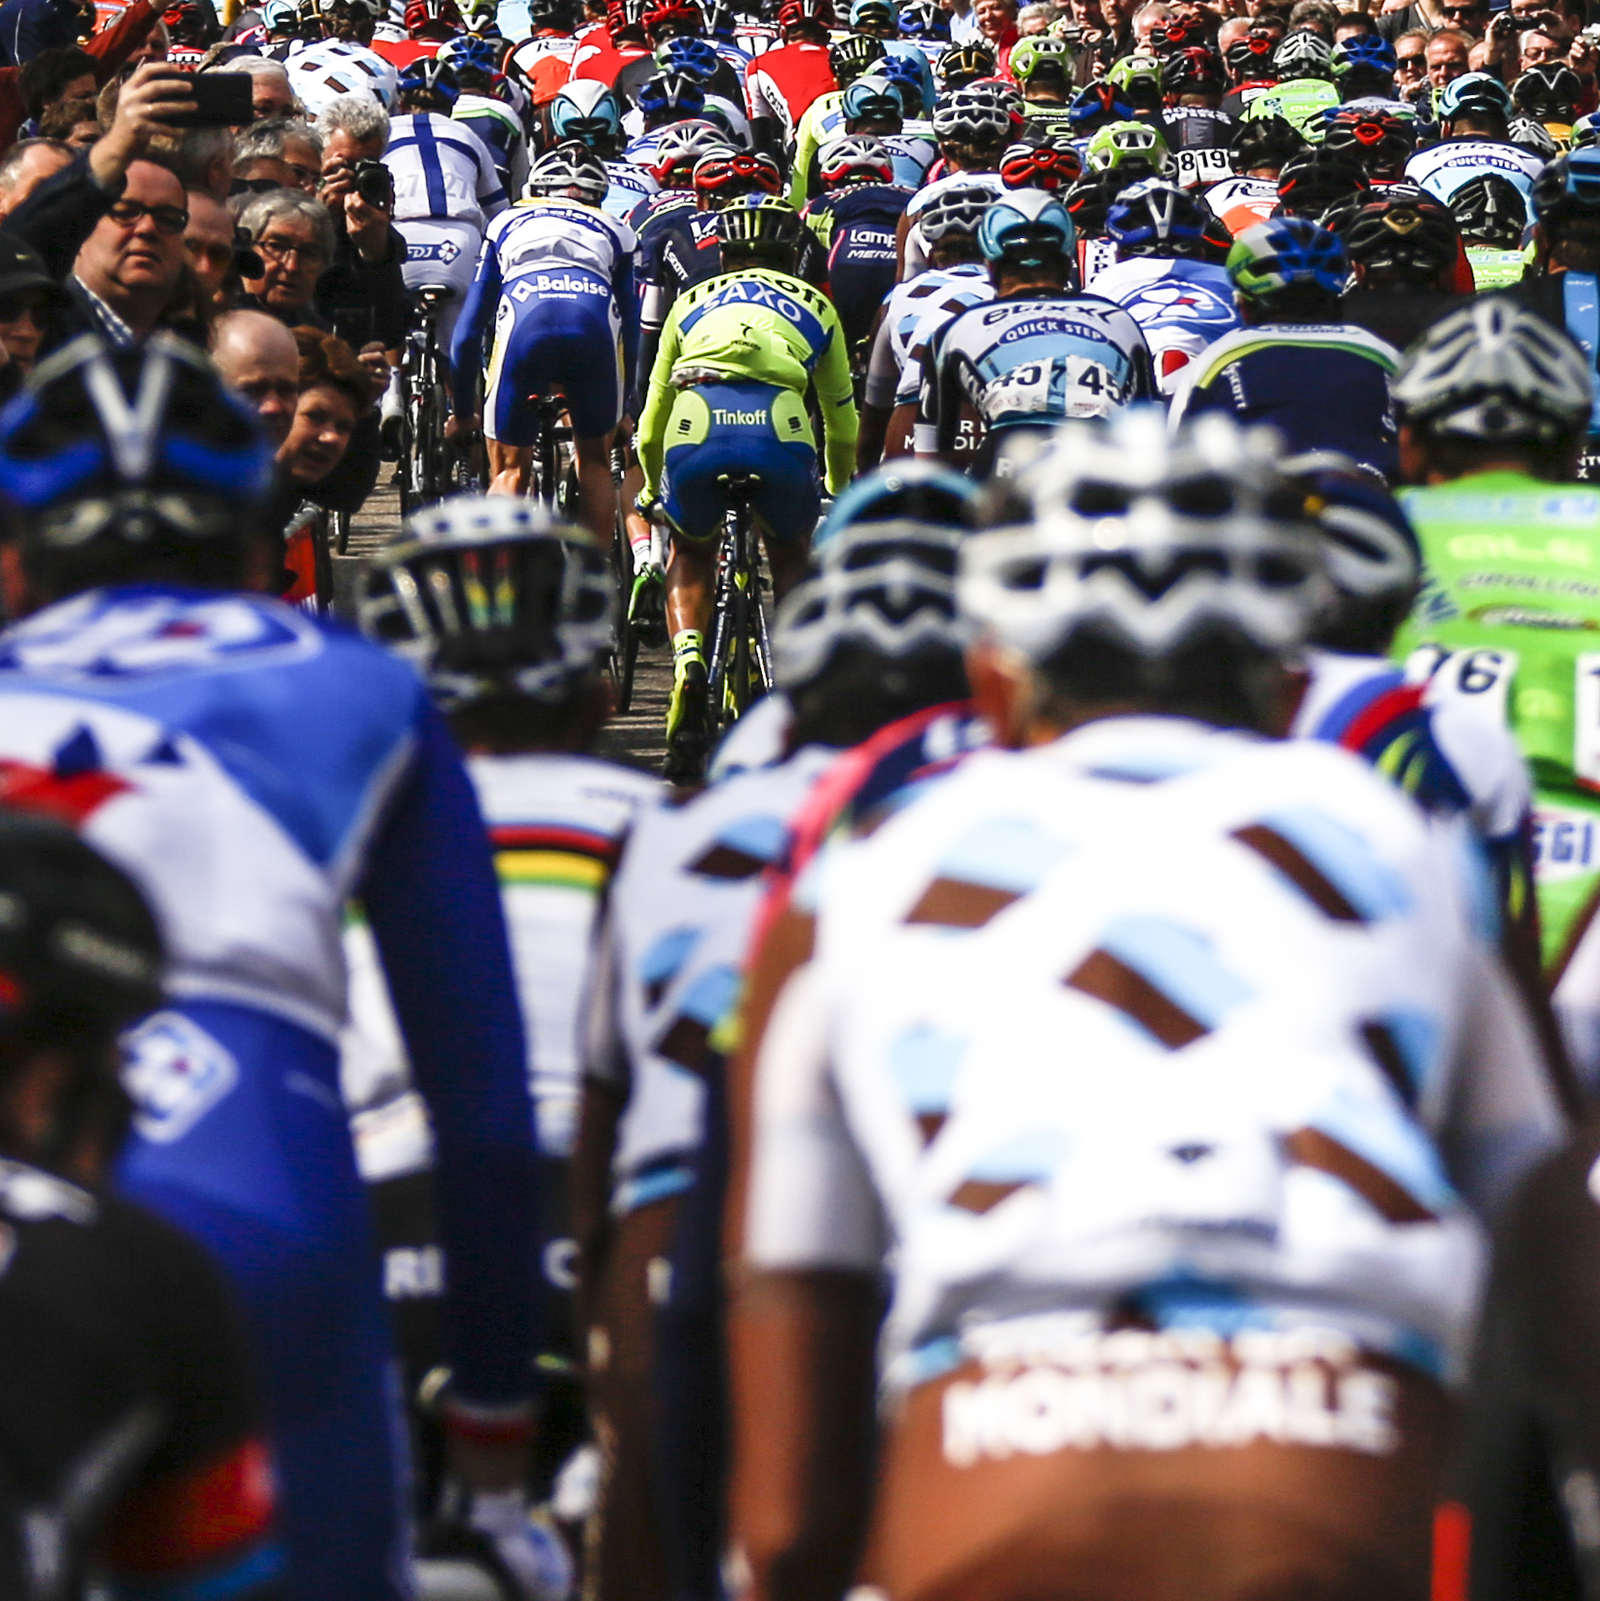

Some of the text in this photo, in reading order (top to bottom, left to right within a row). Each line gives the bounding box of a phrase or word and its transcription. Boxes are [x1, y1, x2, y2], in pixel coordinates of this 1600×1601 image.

[1447, 157, 1520, 172] QUICK STEP
[536, 274, 609, 297] Baloise
[701, 281, 801, 322] SAXO
[1005, 321, 1103, 341] QUICK STEP
[712, 409, 767, 426] Tinkoff
